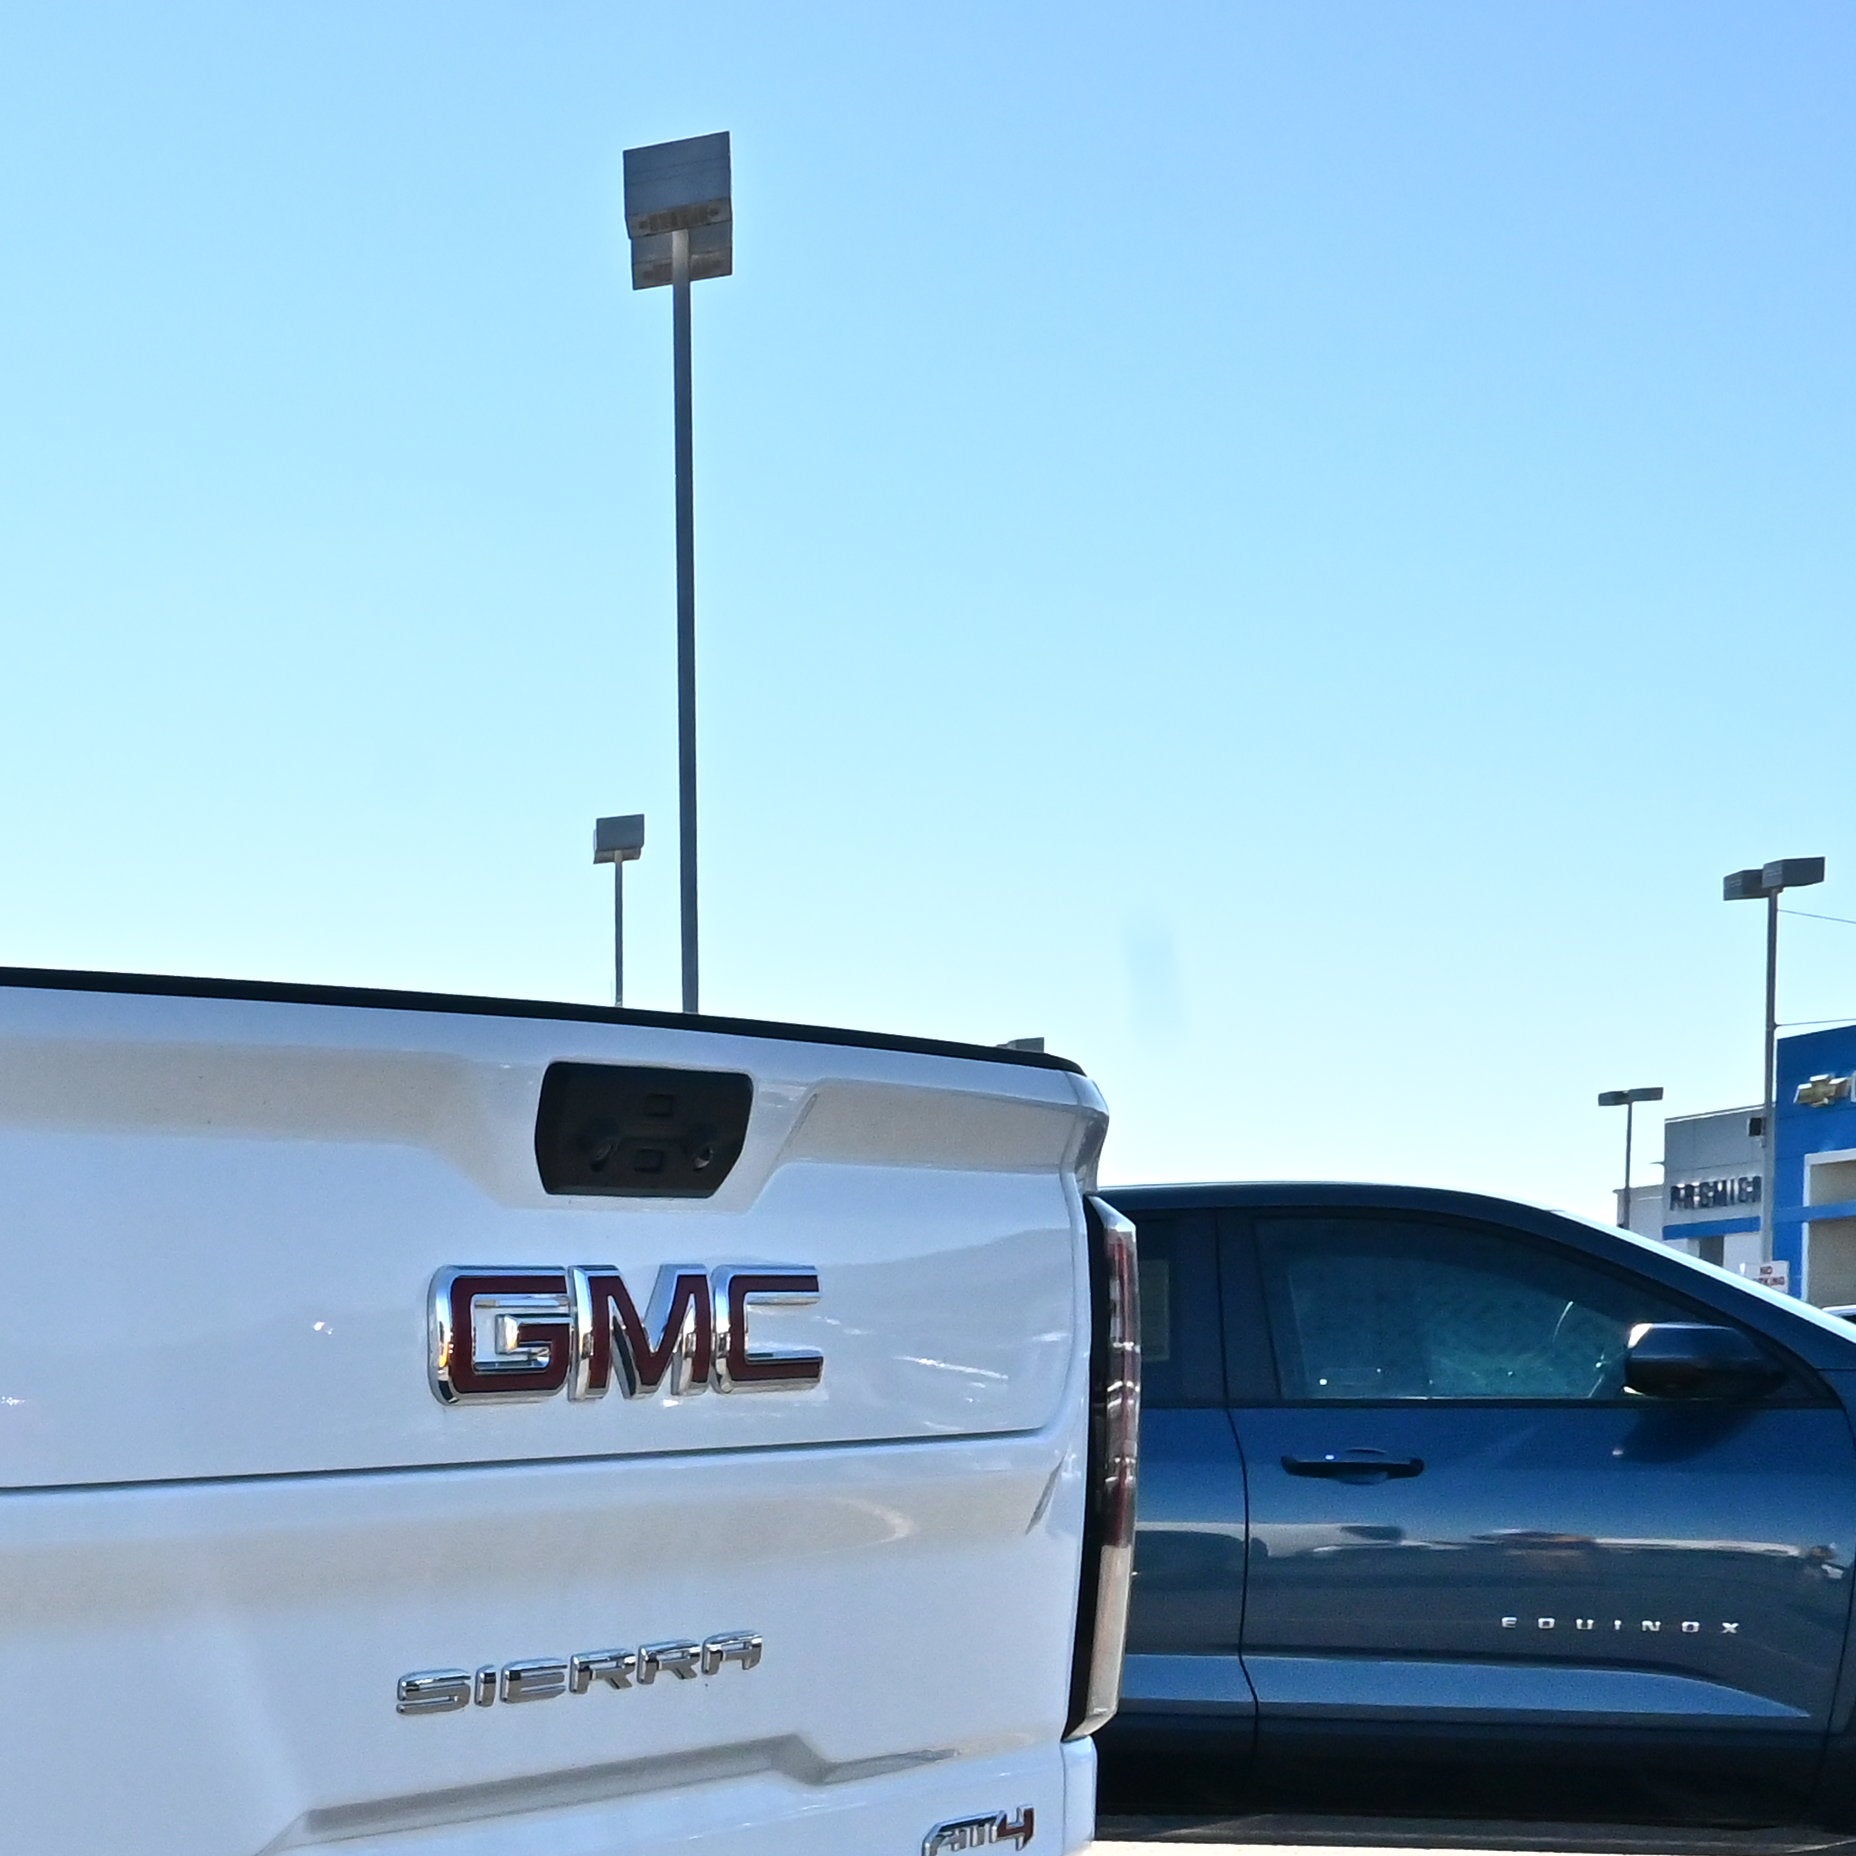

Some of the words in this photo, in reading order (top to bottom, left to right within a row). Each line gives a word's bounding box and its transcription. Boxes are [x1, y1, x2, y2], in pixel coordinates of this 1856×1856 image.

[427, 1263, 825, 1407] GMC
[1501, 1616, 1739, 1634] EQUINOX
[395, 1629, 763, 1716] SIERRA
